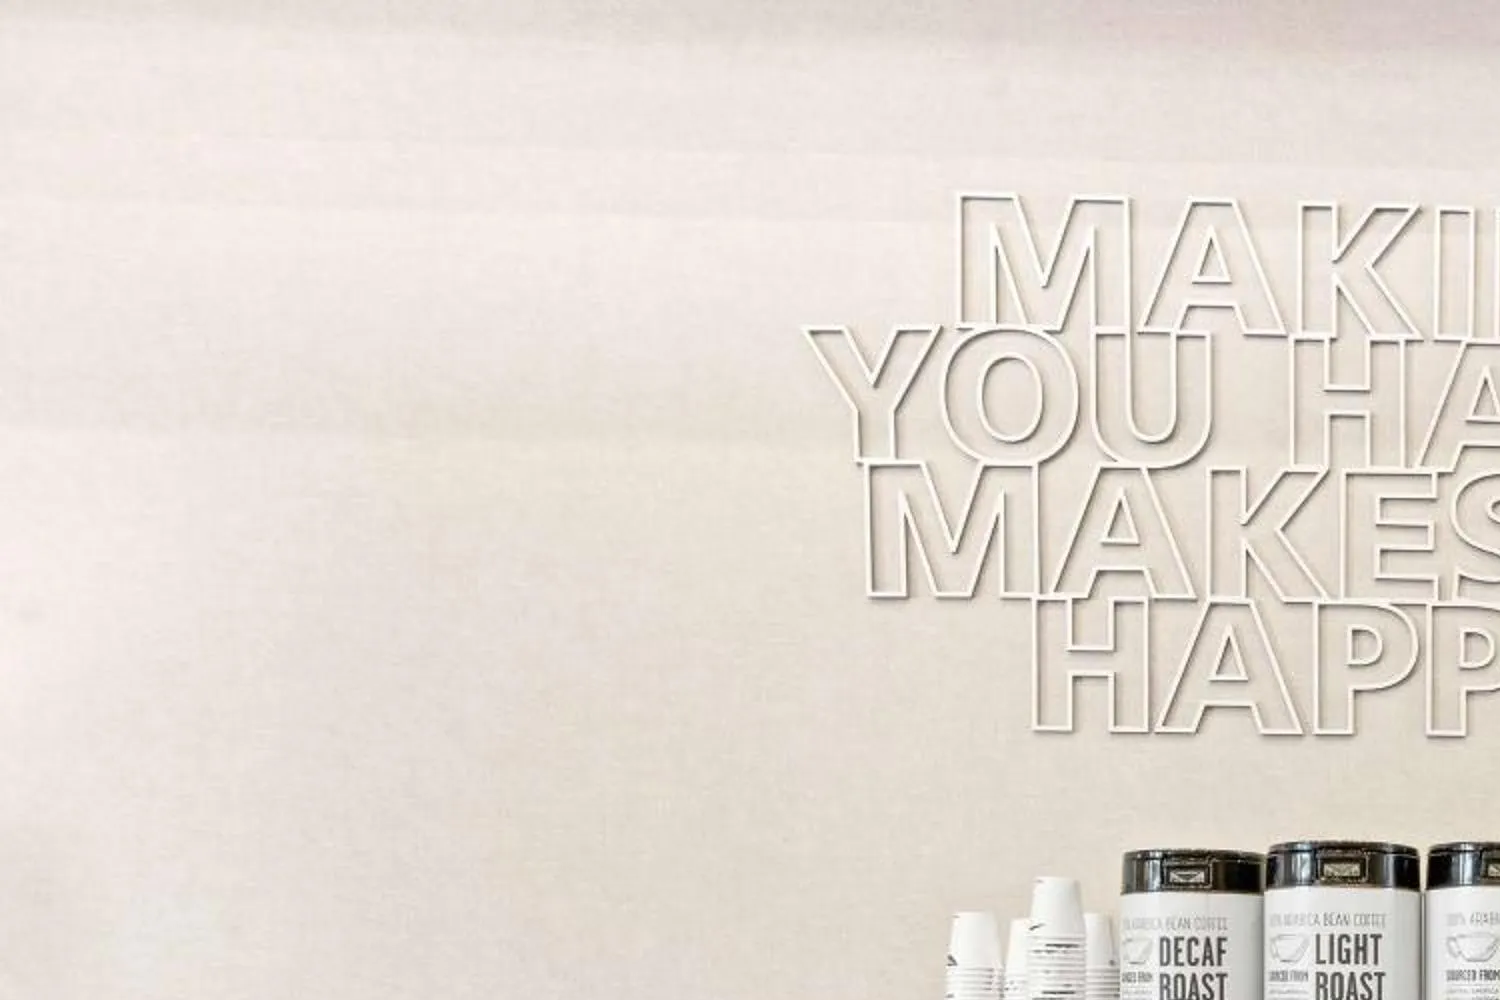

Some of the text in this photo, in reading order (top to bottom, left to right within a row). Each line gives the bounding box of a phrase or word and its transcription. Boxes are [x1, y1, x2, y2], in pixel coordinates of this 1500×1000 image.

[800, 322, 1215, 468] YOU
[1159, 936, 1228, 967] DECAF
[1315, 933, 1383, 965] LIGHT
